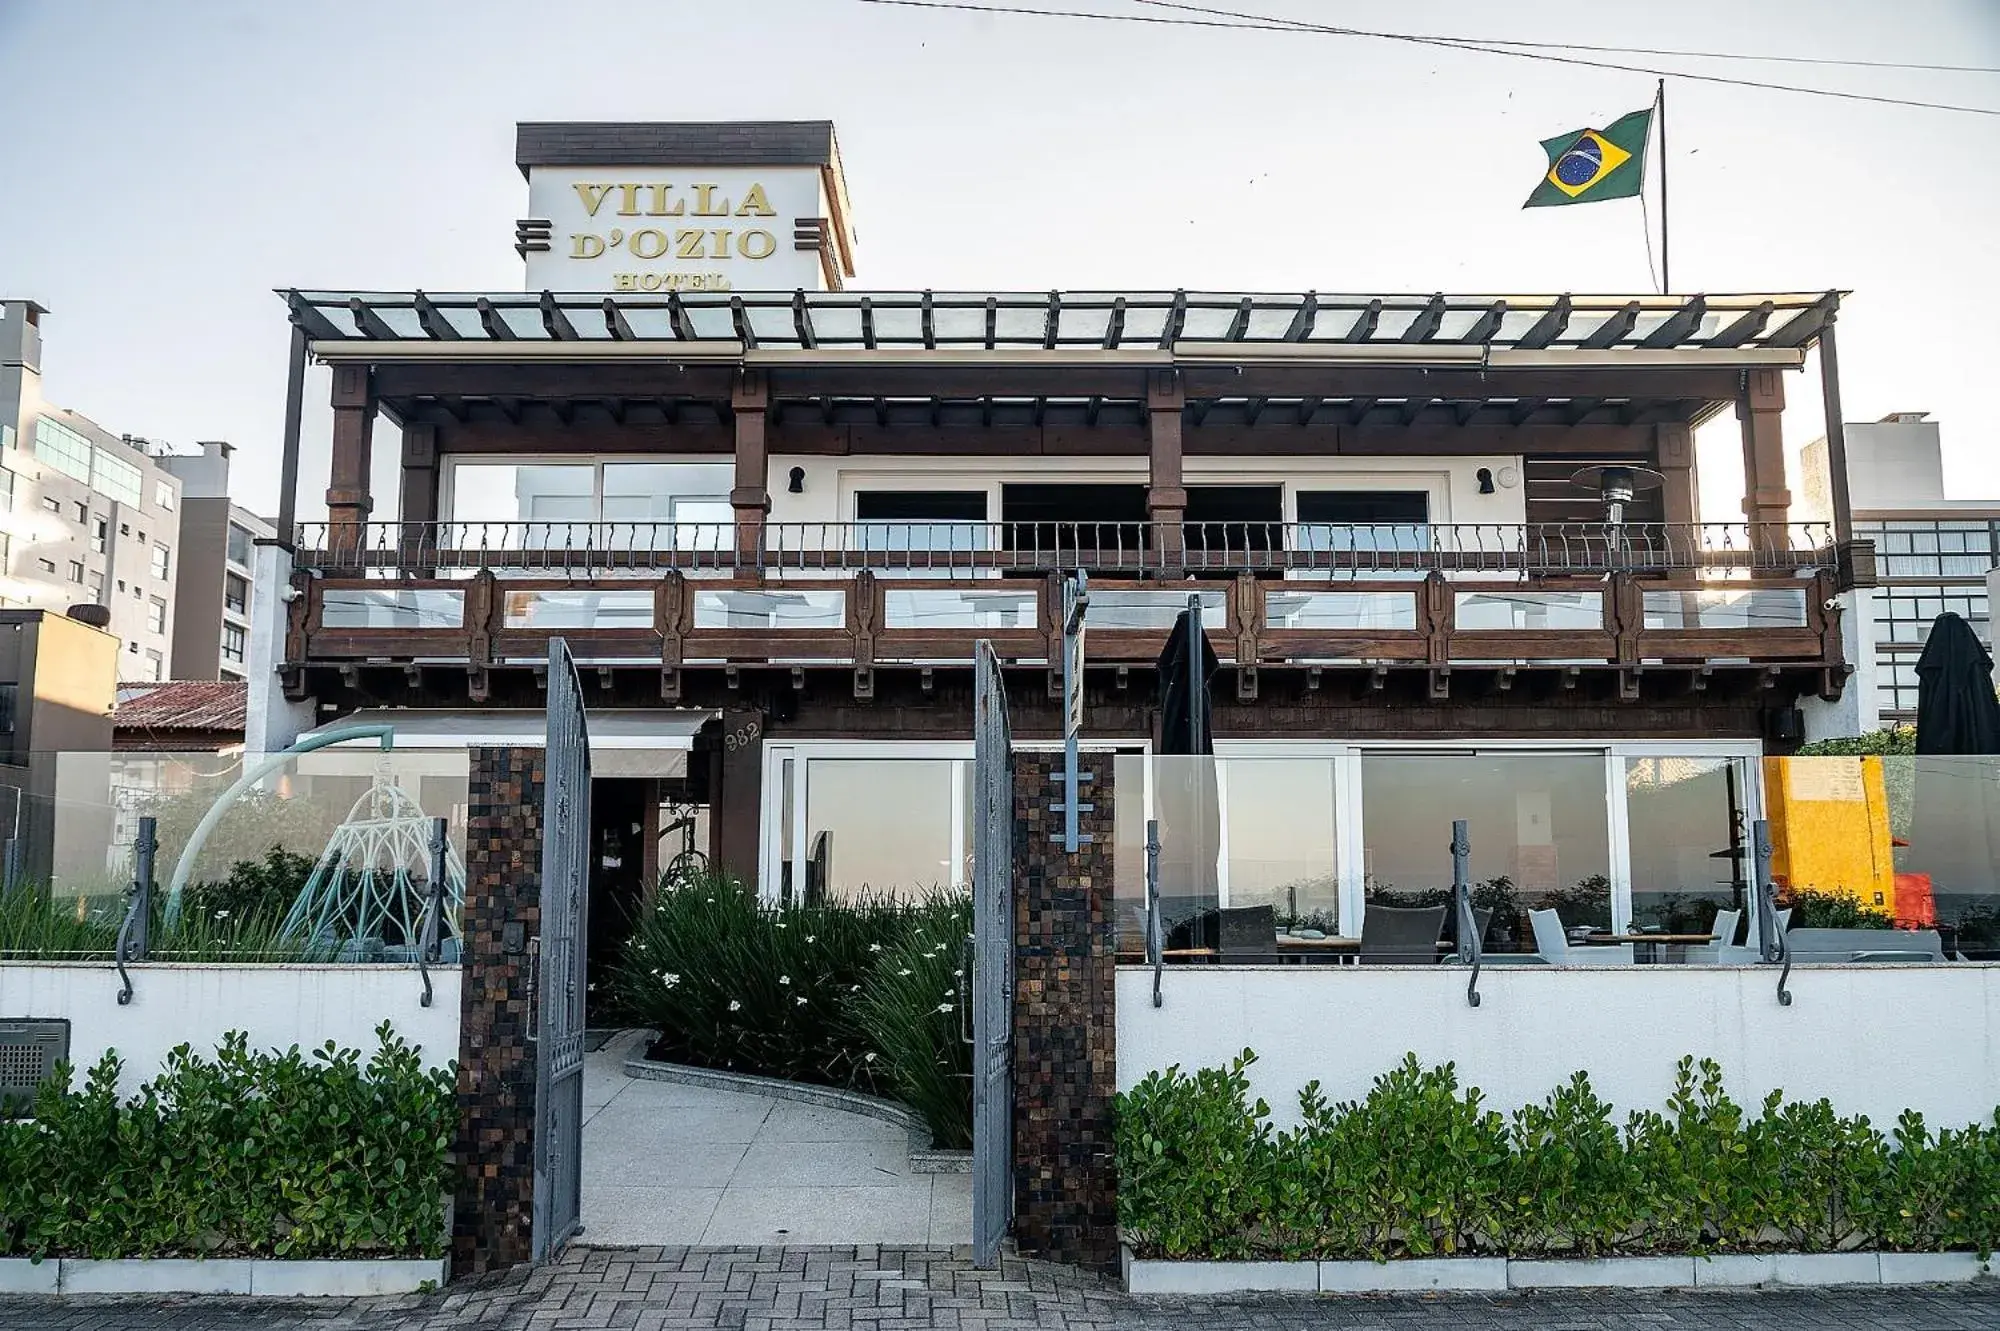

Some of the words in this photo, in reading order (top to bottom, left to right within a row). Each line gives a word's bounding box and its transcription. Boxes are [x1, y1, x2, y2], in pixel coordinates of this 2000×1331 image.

[572, 183, 777, 217] VILLA
[569, 229, 777, 260] D'OZIO
[613, 272, 731, 291] HOTEL
[724, 722, 760, 752] 982
